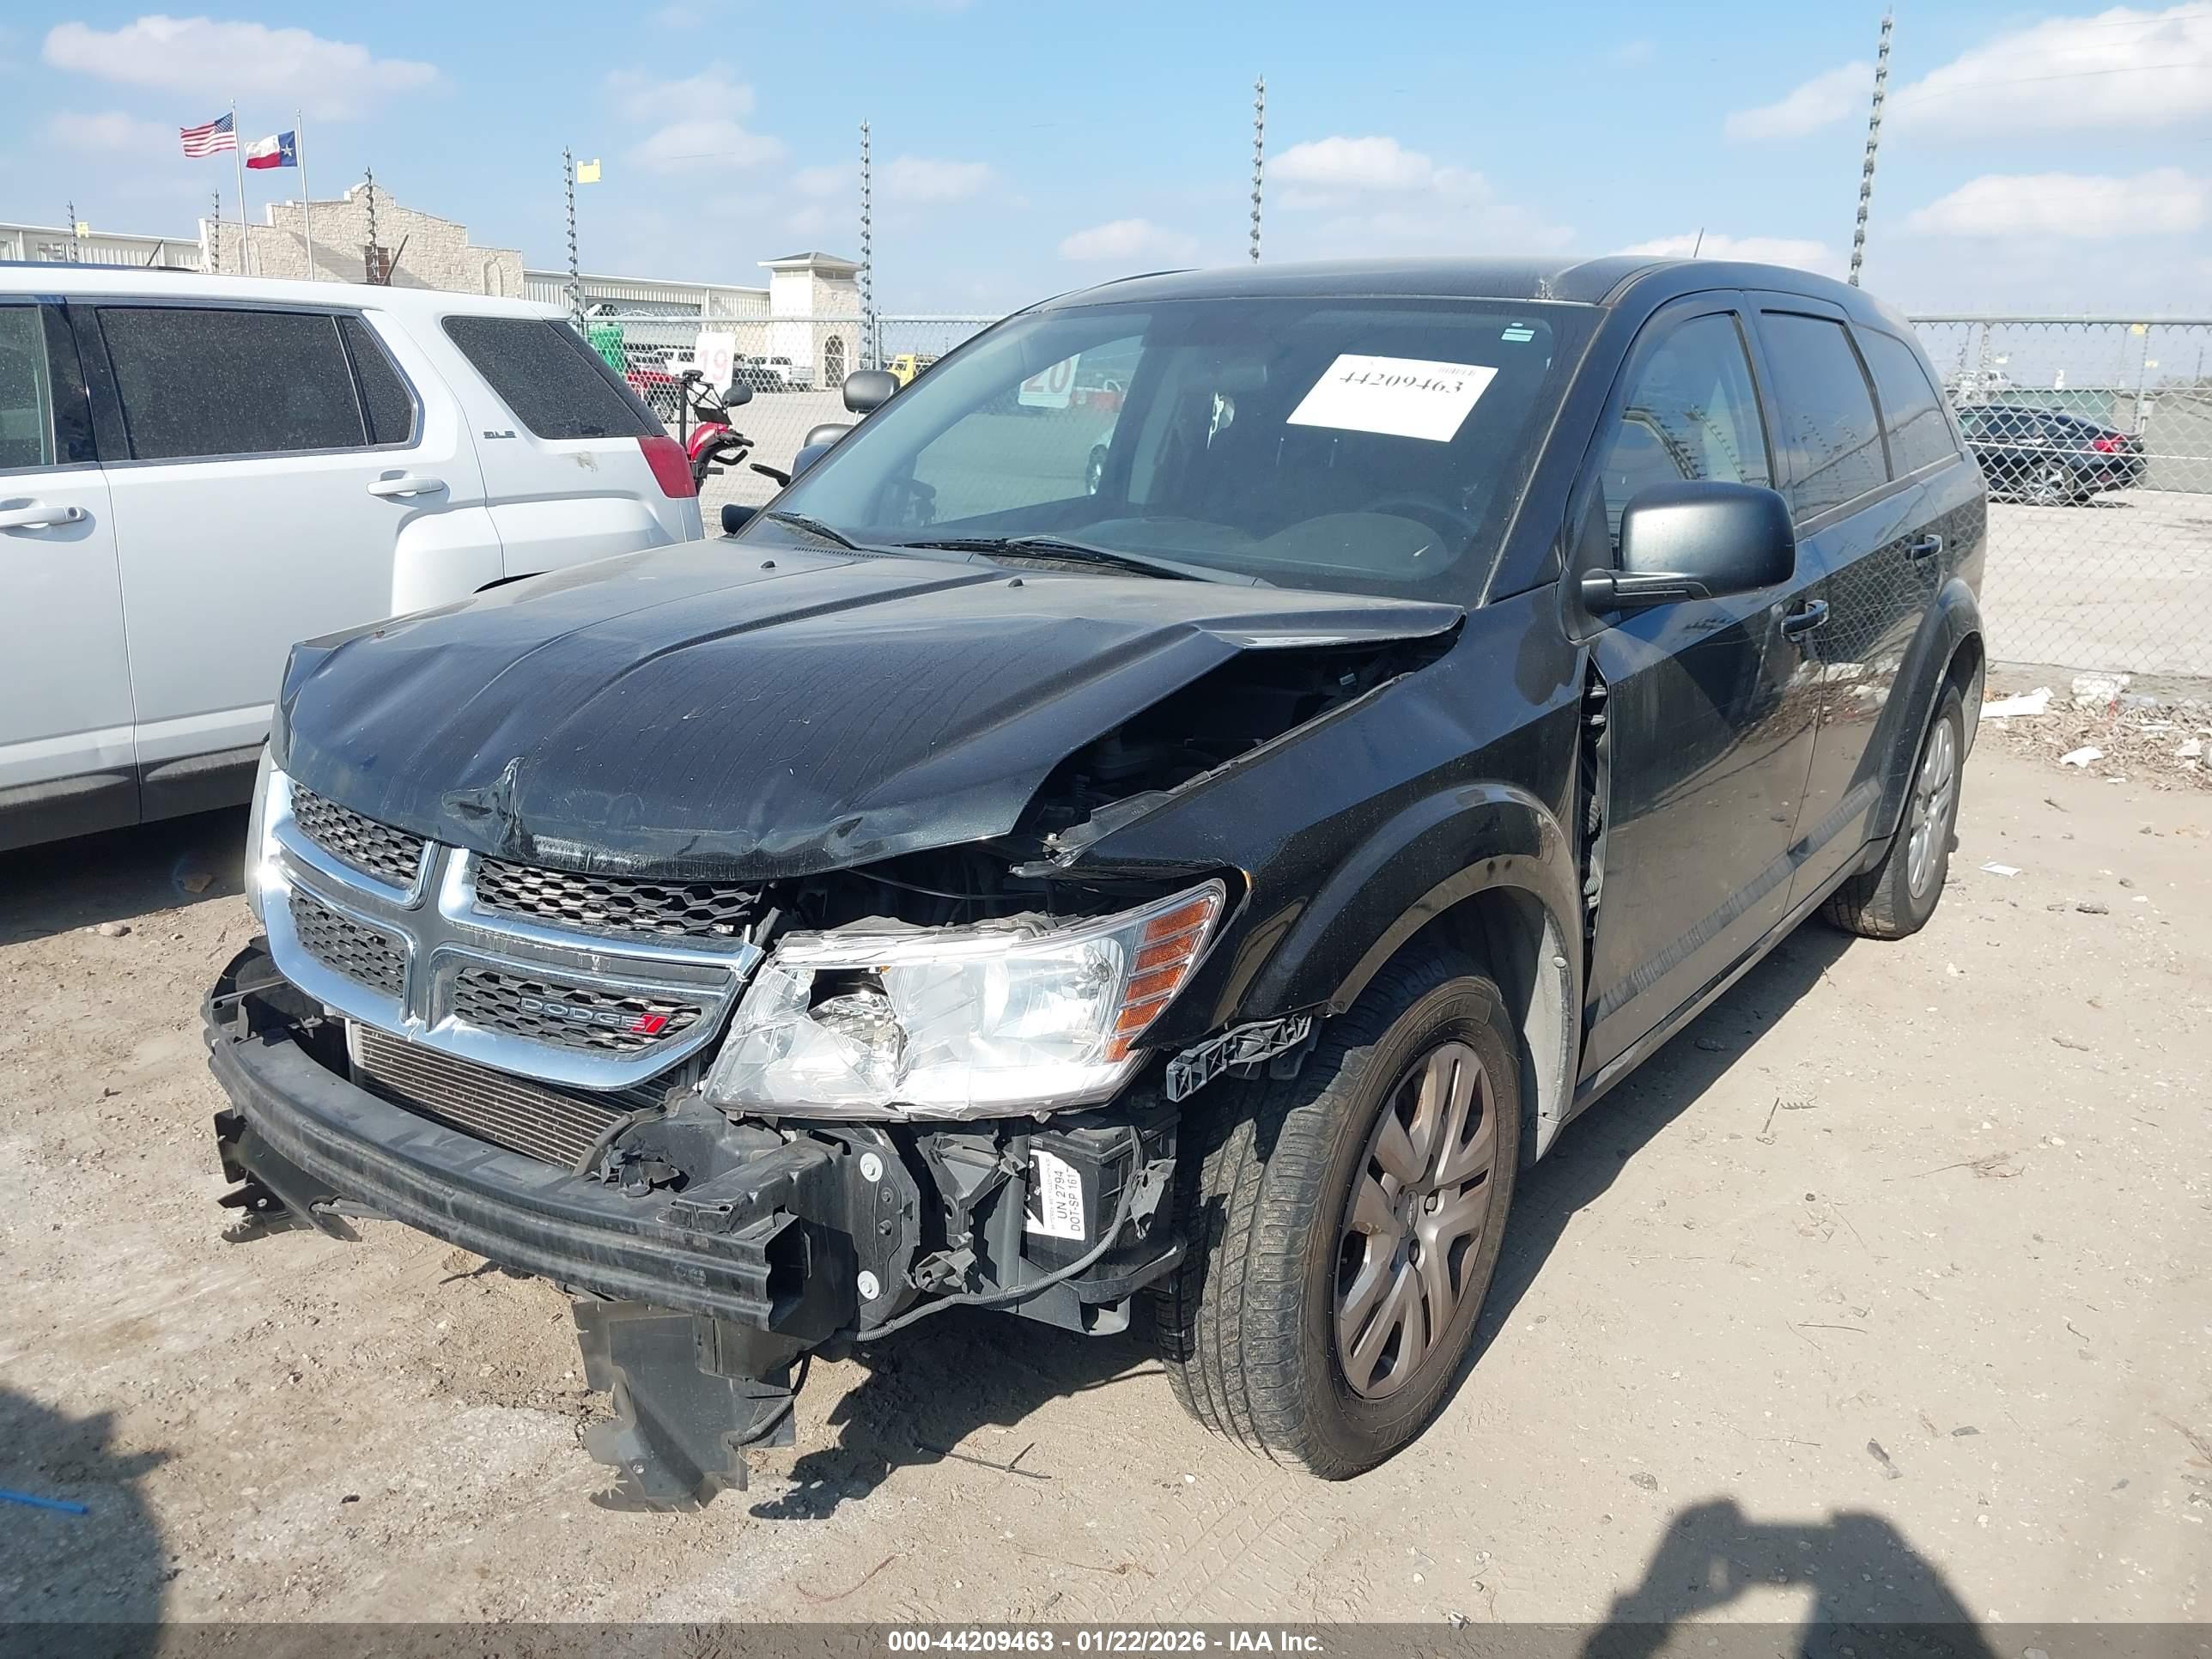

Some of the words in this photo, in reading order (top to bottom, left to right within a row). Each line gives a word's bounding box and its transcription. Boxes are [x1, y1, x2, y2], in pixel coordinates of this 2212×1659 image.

[700, 348, 728, 381] 19
[1340, 371, 1463, 394] 44209463
[520, 997, 646, 1029] DODGE
[1054, 1170, 1066, 1198] 2794
[1057, 1201, 1067, 1219] UN
[1068, 1193, 1080, 1231] DOT-SP
